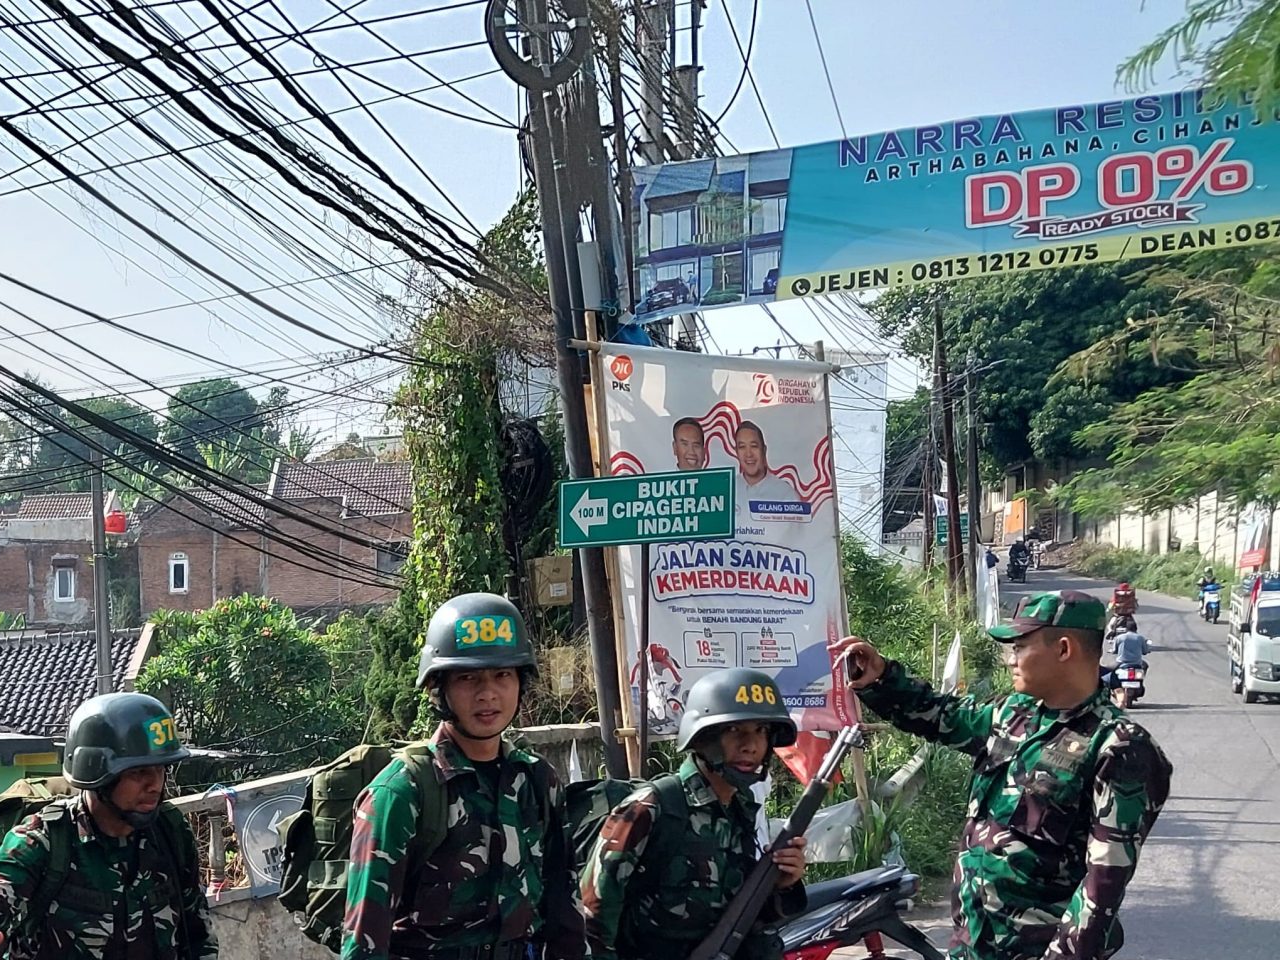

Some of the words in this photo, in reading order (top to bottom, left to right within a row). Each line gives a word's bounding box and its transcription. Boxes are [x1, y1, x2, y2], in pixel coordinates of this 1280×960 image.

[839, 113, 1024, 168] NARRA
[864, 135, 1119, 184] ARTHABAHANA,
[1133, 108, 1280, 145] CIHANJ
[964, 162, 1081, 228] DP
[1097, 137, 1254, 208] 0%
[1045, 216, 1106, 236] READY
[1110, 204, 1170, 224] STOCK
[813, 267, 889, 293] JEJEN
[911, 258, 970, 281] 0813
[977, 252, 1031, 272] 1212
[1039, 243, 1099, 266] 0775
[1141, 228, 1216, 254] DEAN
[612, 380, 631, 392] PKS
[638, 478, 699, 499] BUKIT
[577, 507, 594, 519] 100
[596, 507, 604, 518] M
[612, 495, 725, 519] CIPAGERAN
[758, 504, 783, 512] GILANG
[637, 516, 699, 535] INDAH
[735, 527, 765, 536] riahkan!
[662, 548, 724, 571] JALAN
[730, 548, 801, 575] SANTAI
[656, 568, 809, 598] KEMERDEKAAN
[461, 617, 513, 644] 384
[696, 640, 711, 656] 18
[735, 684, 776, 705] 486
